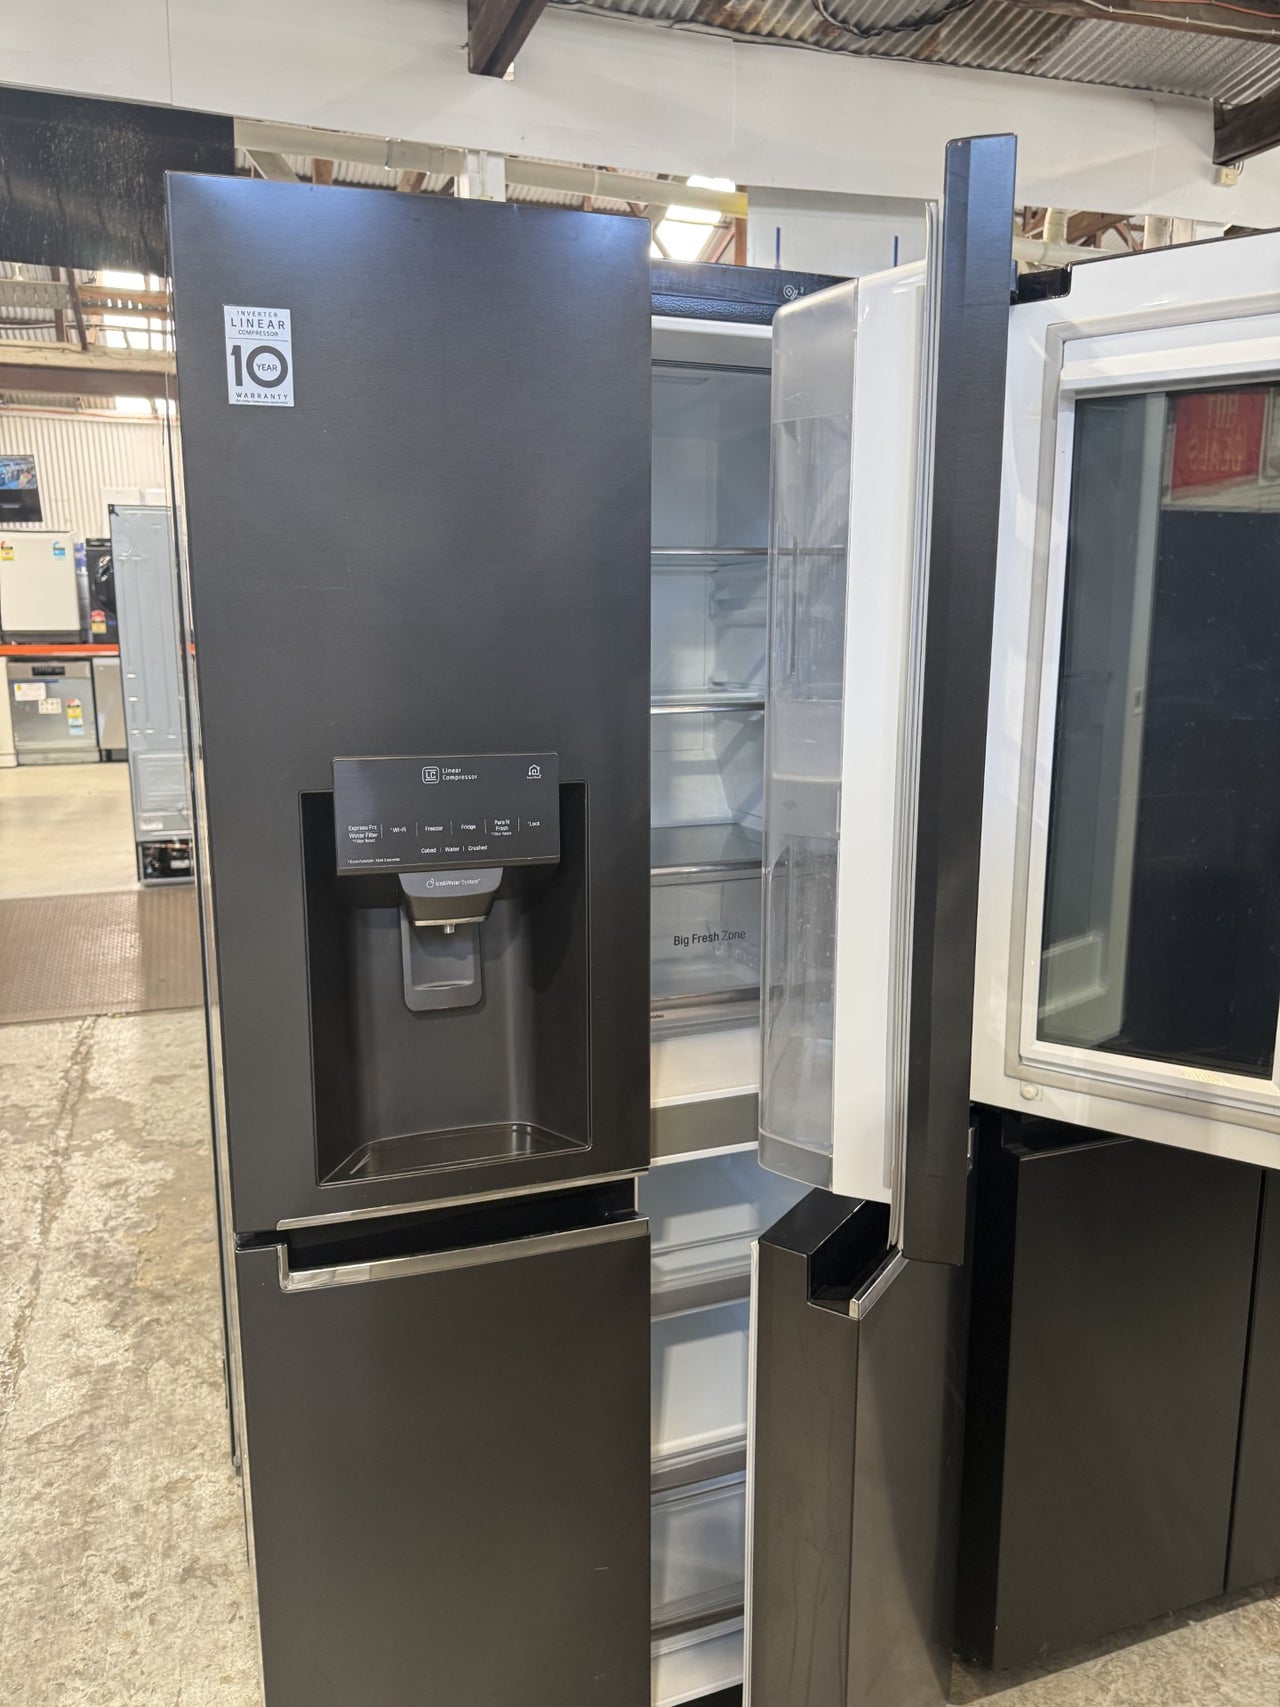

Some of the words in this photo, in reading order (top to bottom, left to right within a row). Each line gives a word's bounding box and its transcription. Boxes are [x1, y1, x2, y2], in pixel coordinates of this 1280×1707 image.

[231, 318, 285, 329] LINEAR
[231, 345, 288, 388] 10
[256, 363, 278, 371] YEAR
[673, 935, 690, 947] Big
[691, 931, 720, 944] Fresh
[721, 930, 746, 941] Zone
